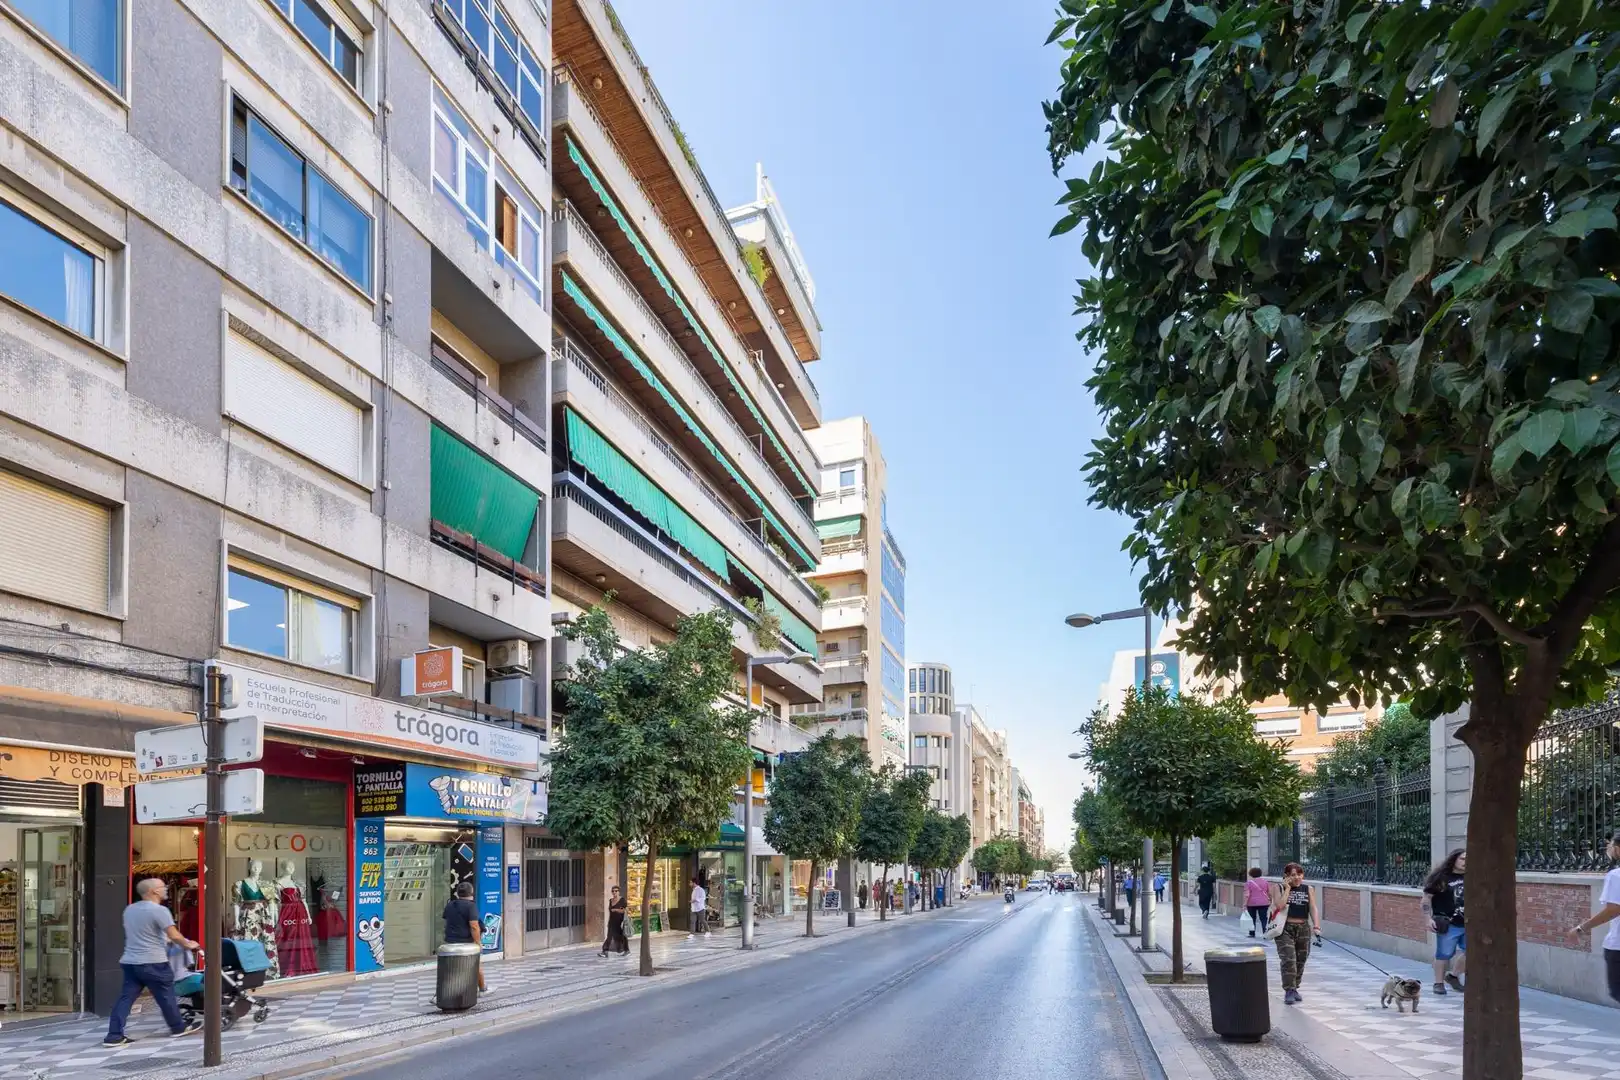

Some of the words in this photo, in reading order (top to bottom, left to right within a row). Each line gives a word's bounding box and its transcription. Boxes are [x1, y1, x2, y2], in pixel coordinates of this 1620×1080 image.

[422, 679, 448, 689] trágora
[247, 678, 286, 694] Escuela
[289, 687, 341, 705] Profesional
[247, 689, 260, 698] de
[263, 691, 317, 710] Traducción
[247, 700, 254, 708] e
[257, 701, 328, 721] Interpretación
[394, 710, 479, 746] trágora
[49, 765, 60, 777] Y
[356, 770, 403, 783] TORNILLO
[356, 784, 363, 793] Y
[365, 781, 404, 792] PANTALLA
[451, 777, 512, 797] TORNILLO
[451, 795, 459, 806] Y
[463, 795, 512, 809] PANTALLA
[450, 807, 473, 815] MOBILE
[363, 825, 378, 833] 602
[363, 836, 378, 845] 538
[363, 848, 378, 856] 863
[361, 862, 382, 872] QUICK
[359, 871, 382, 888] FIX
